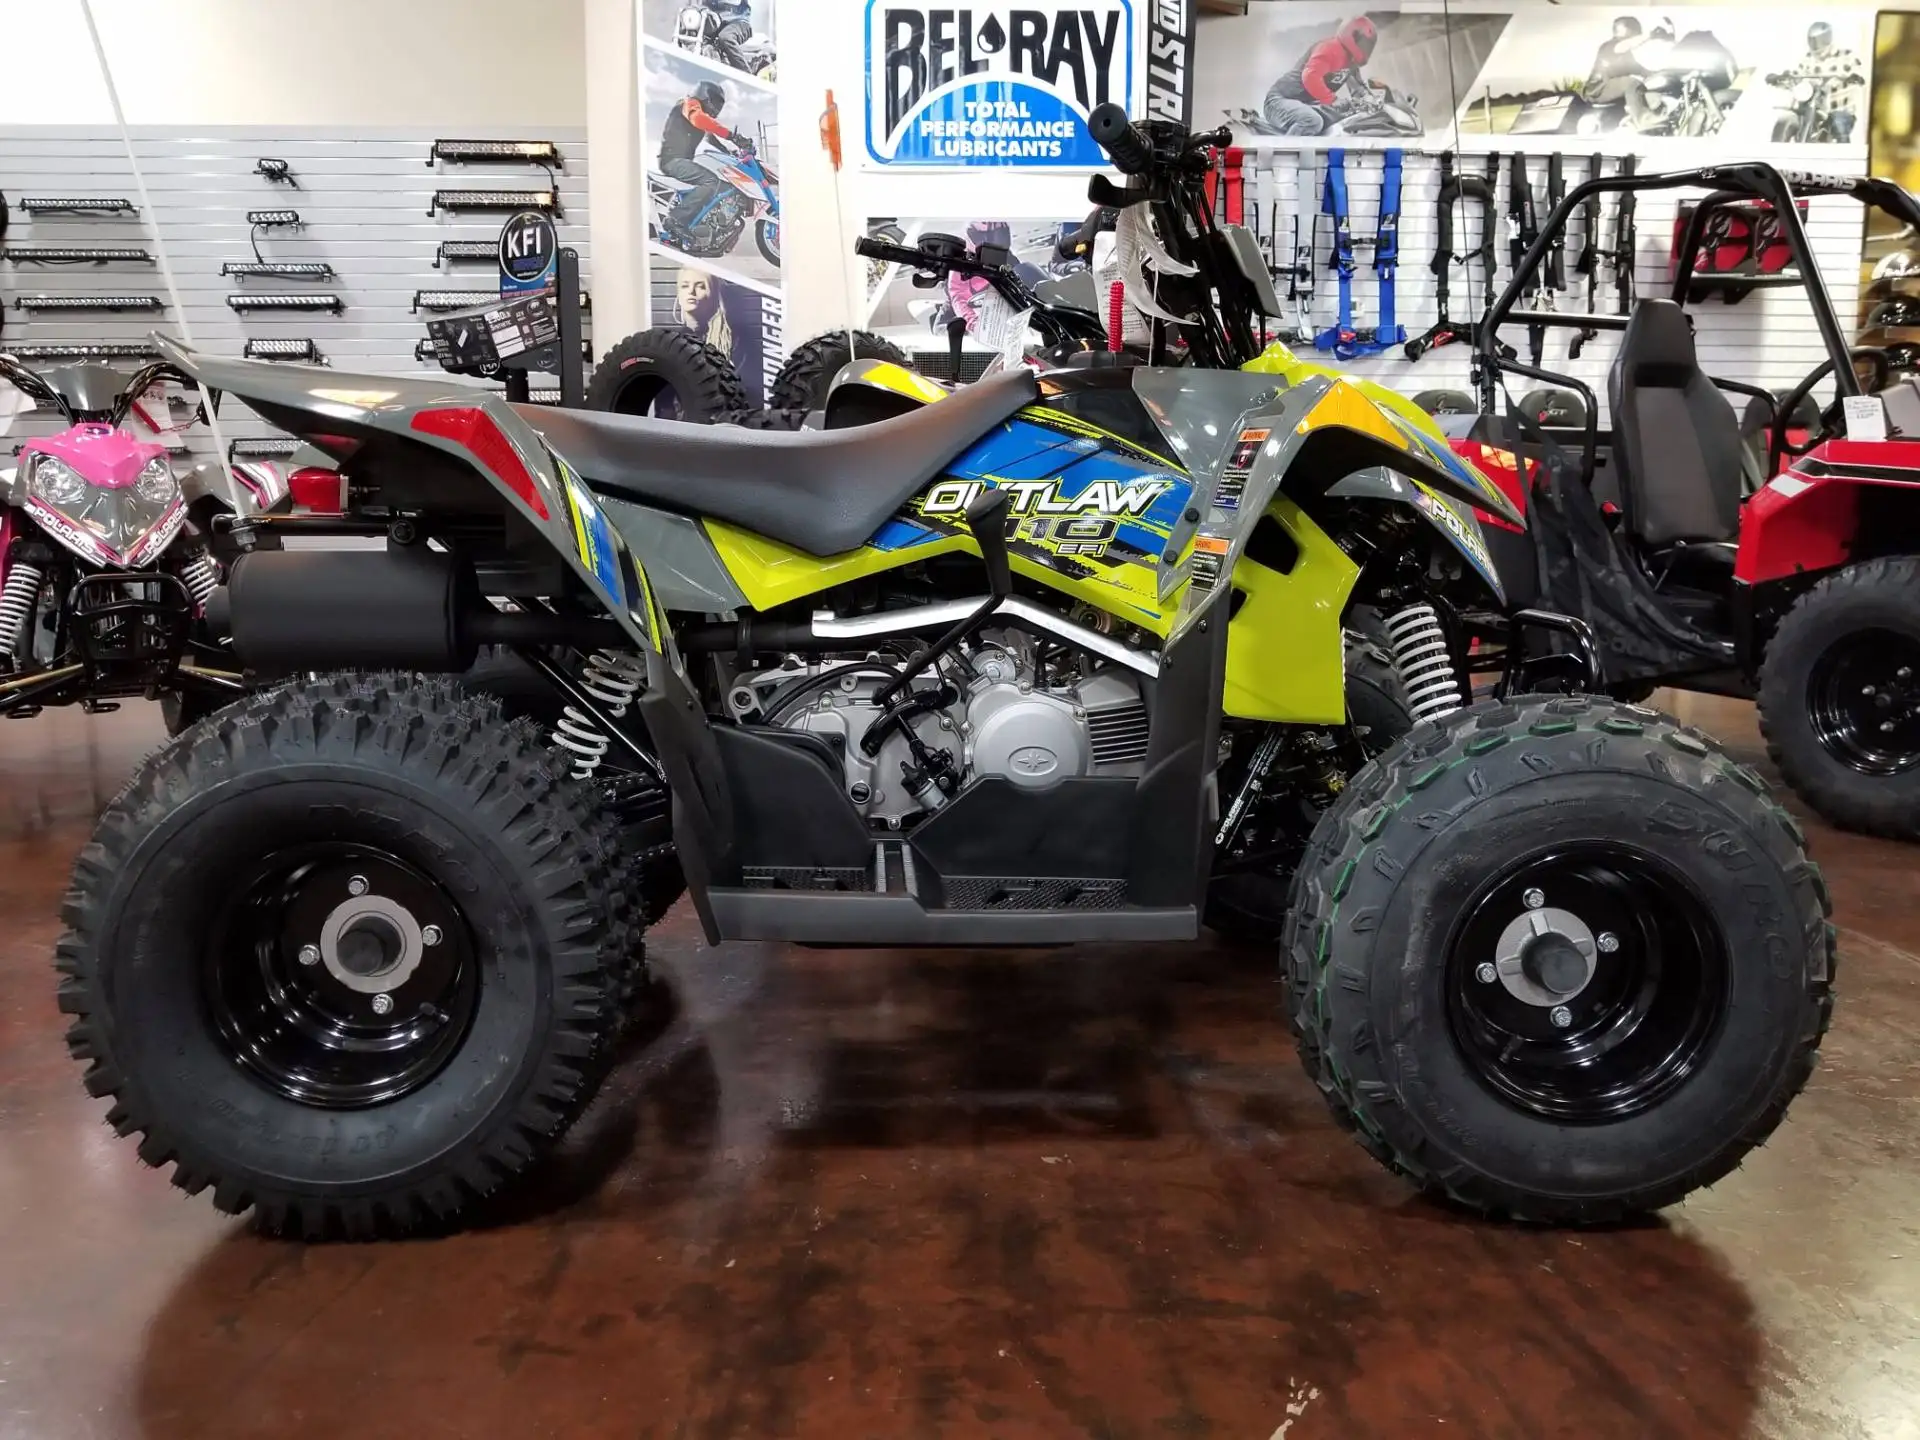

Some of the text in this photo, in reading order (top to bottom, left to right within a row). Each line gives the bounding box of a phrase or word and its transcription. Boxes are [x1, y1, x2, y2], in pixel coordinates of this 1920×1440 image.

[1149, 30, 1186, 124] STR
[965, 101, 1031, 118] TOTAL
[920, 120, 1075, 138] PERFORMANCE
[933, 140, 1062, 157] LUBRICANTS
[507, 226, 542, 259] KFI
[761, 296, 782, 410] TRONGER
[34, 505, 96, 555] POLARIS
[145, 508, 185, 556] POLARIS
[1057, 543, 1103, 555] EFI
